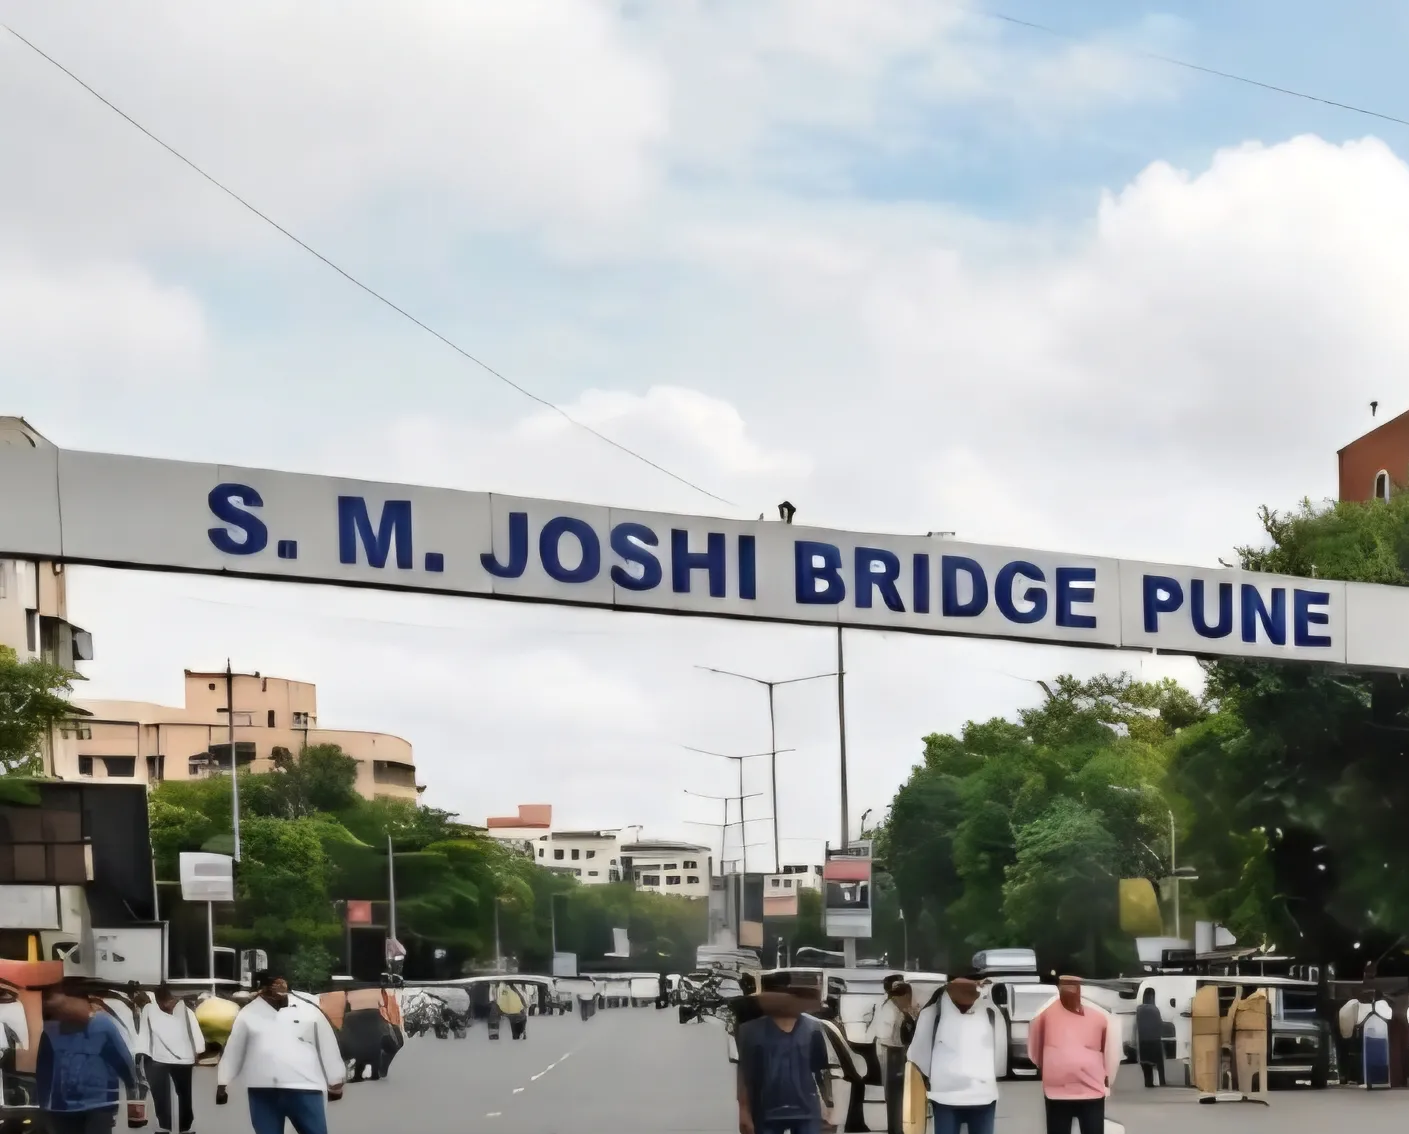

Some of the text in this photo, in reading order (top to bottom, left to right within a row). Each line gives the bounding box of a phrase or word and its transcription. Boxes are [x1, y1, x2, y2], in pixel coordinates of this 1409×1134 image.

[210, 484, 1329, 647] S. M. JOSHI BRIDGE PUNE
